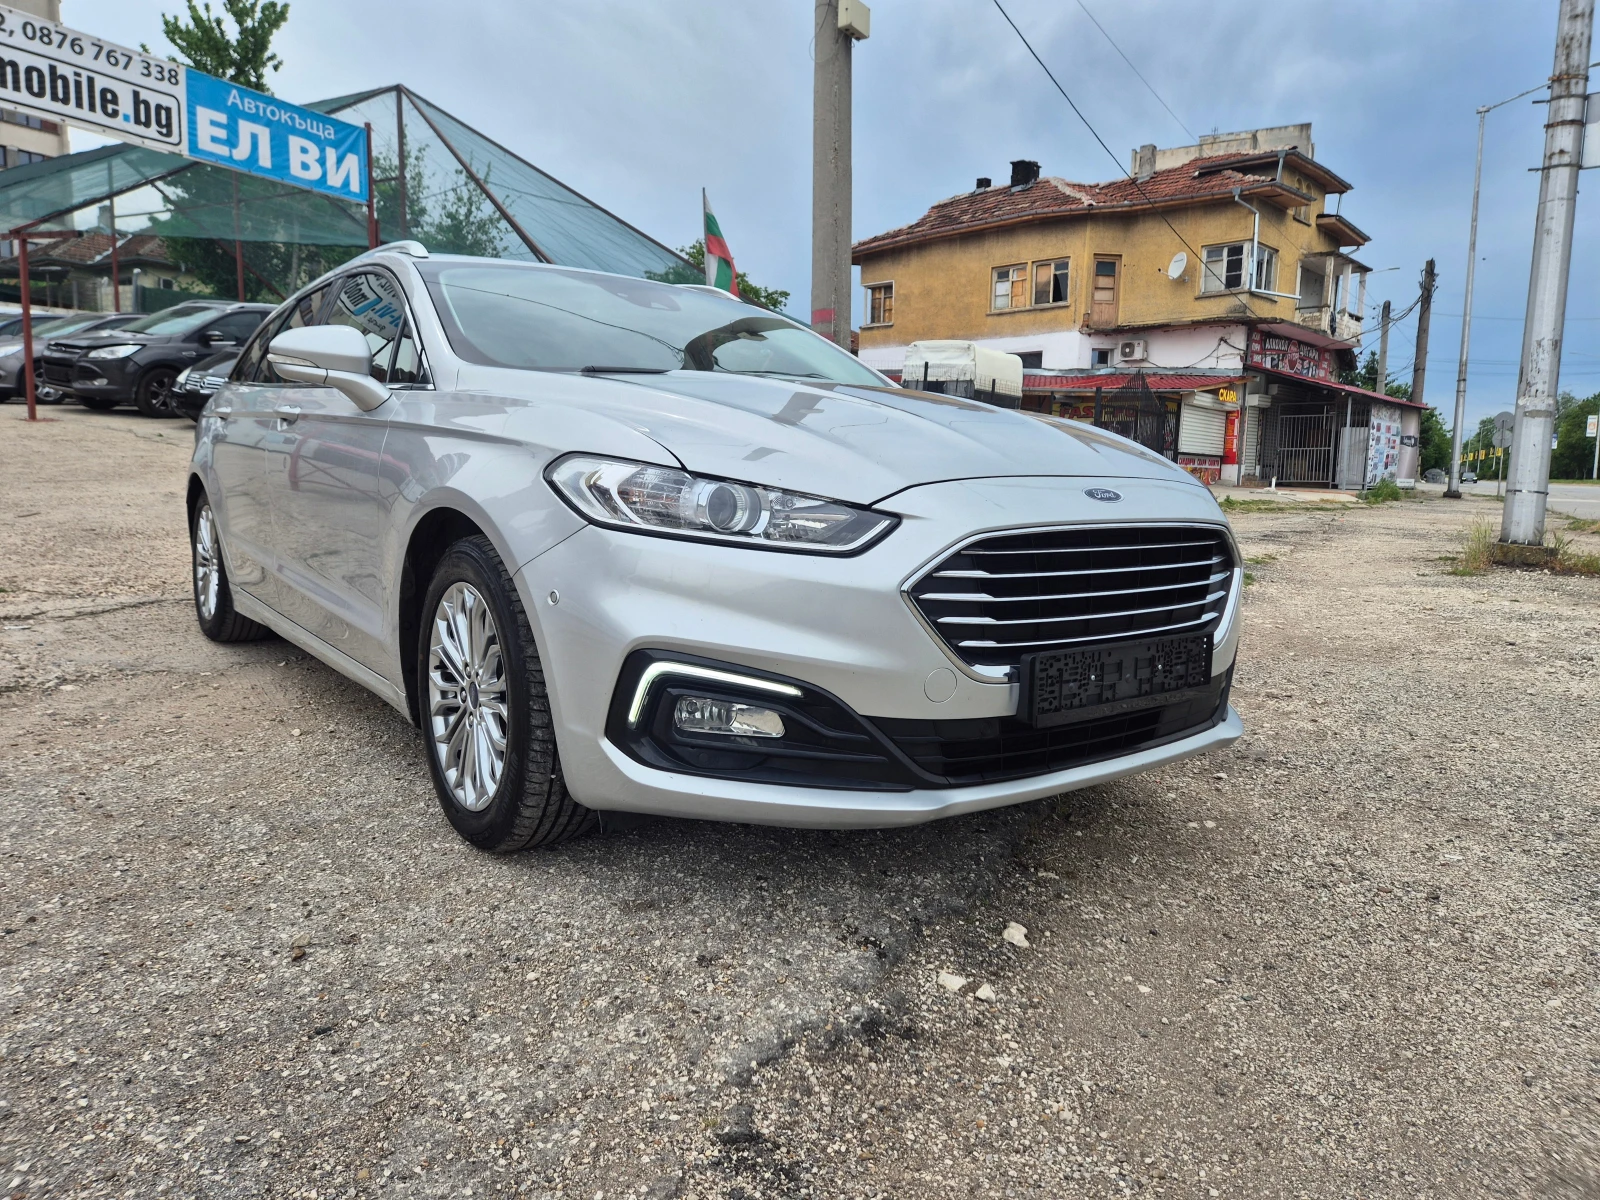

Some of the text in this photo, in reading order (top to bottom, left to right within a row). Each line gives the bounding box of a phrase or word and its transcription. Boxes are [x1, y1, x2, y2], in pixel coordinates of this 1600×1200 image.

[22, 21, 85, 56] 0876
[91, 42, 133, 71] 767
[140, 59, 180, 86] 338
[0, 56, 173, 138] mobile.bg
[227, 89, 336, 141] Автокъща
[196, 105, 361, 194] ЕЛ ВИ
[1060, 404, 1097, 419] FAS
[1219, 388, 1238, 402] СКАРА
